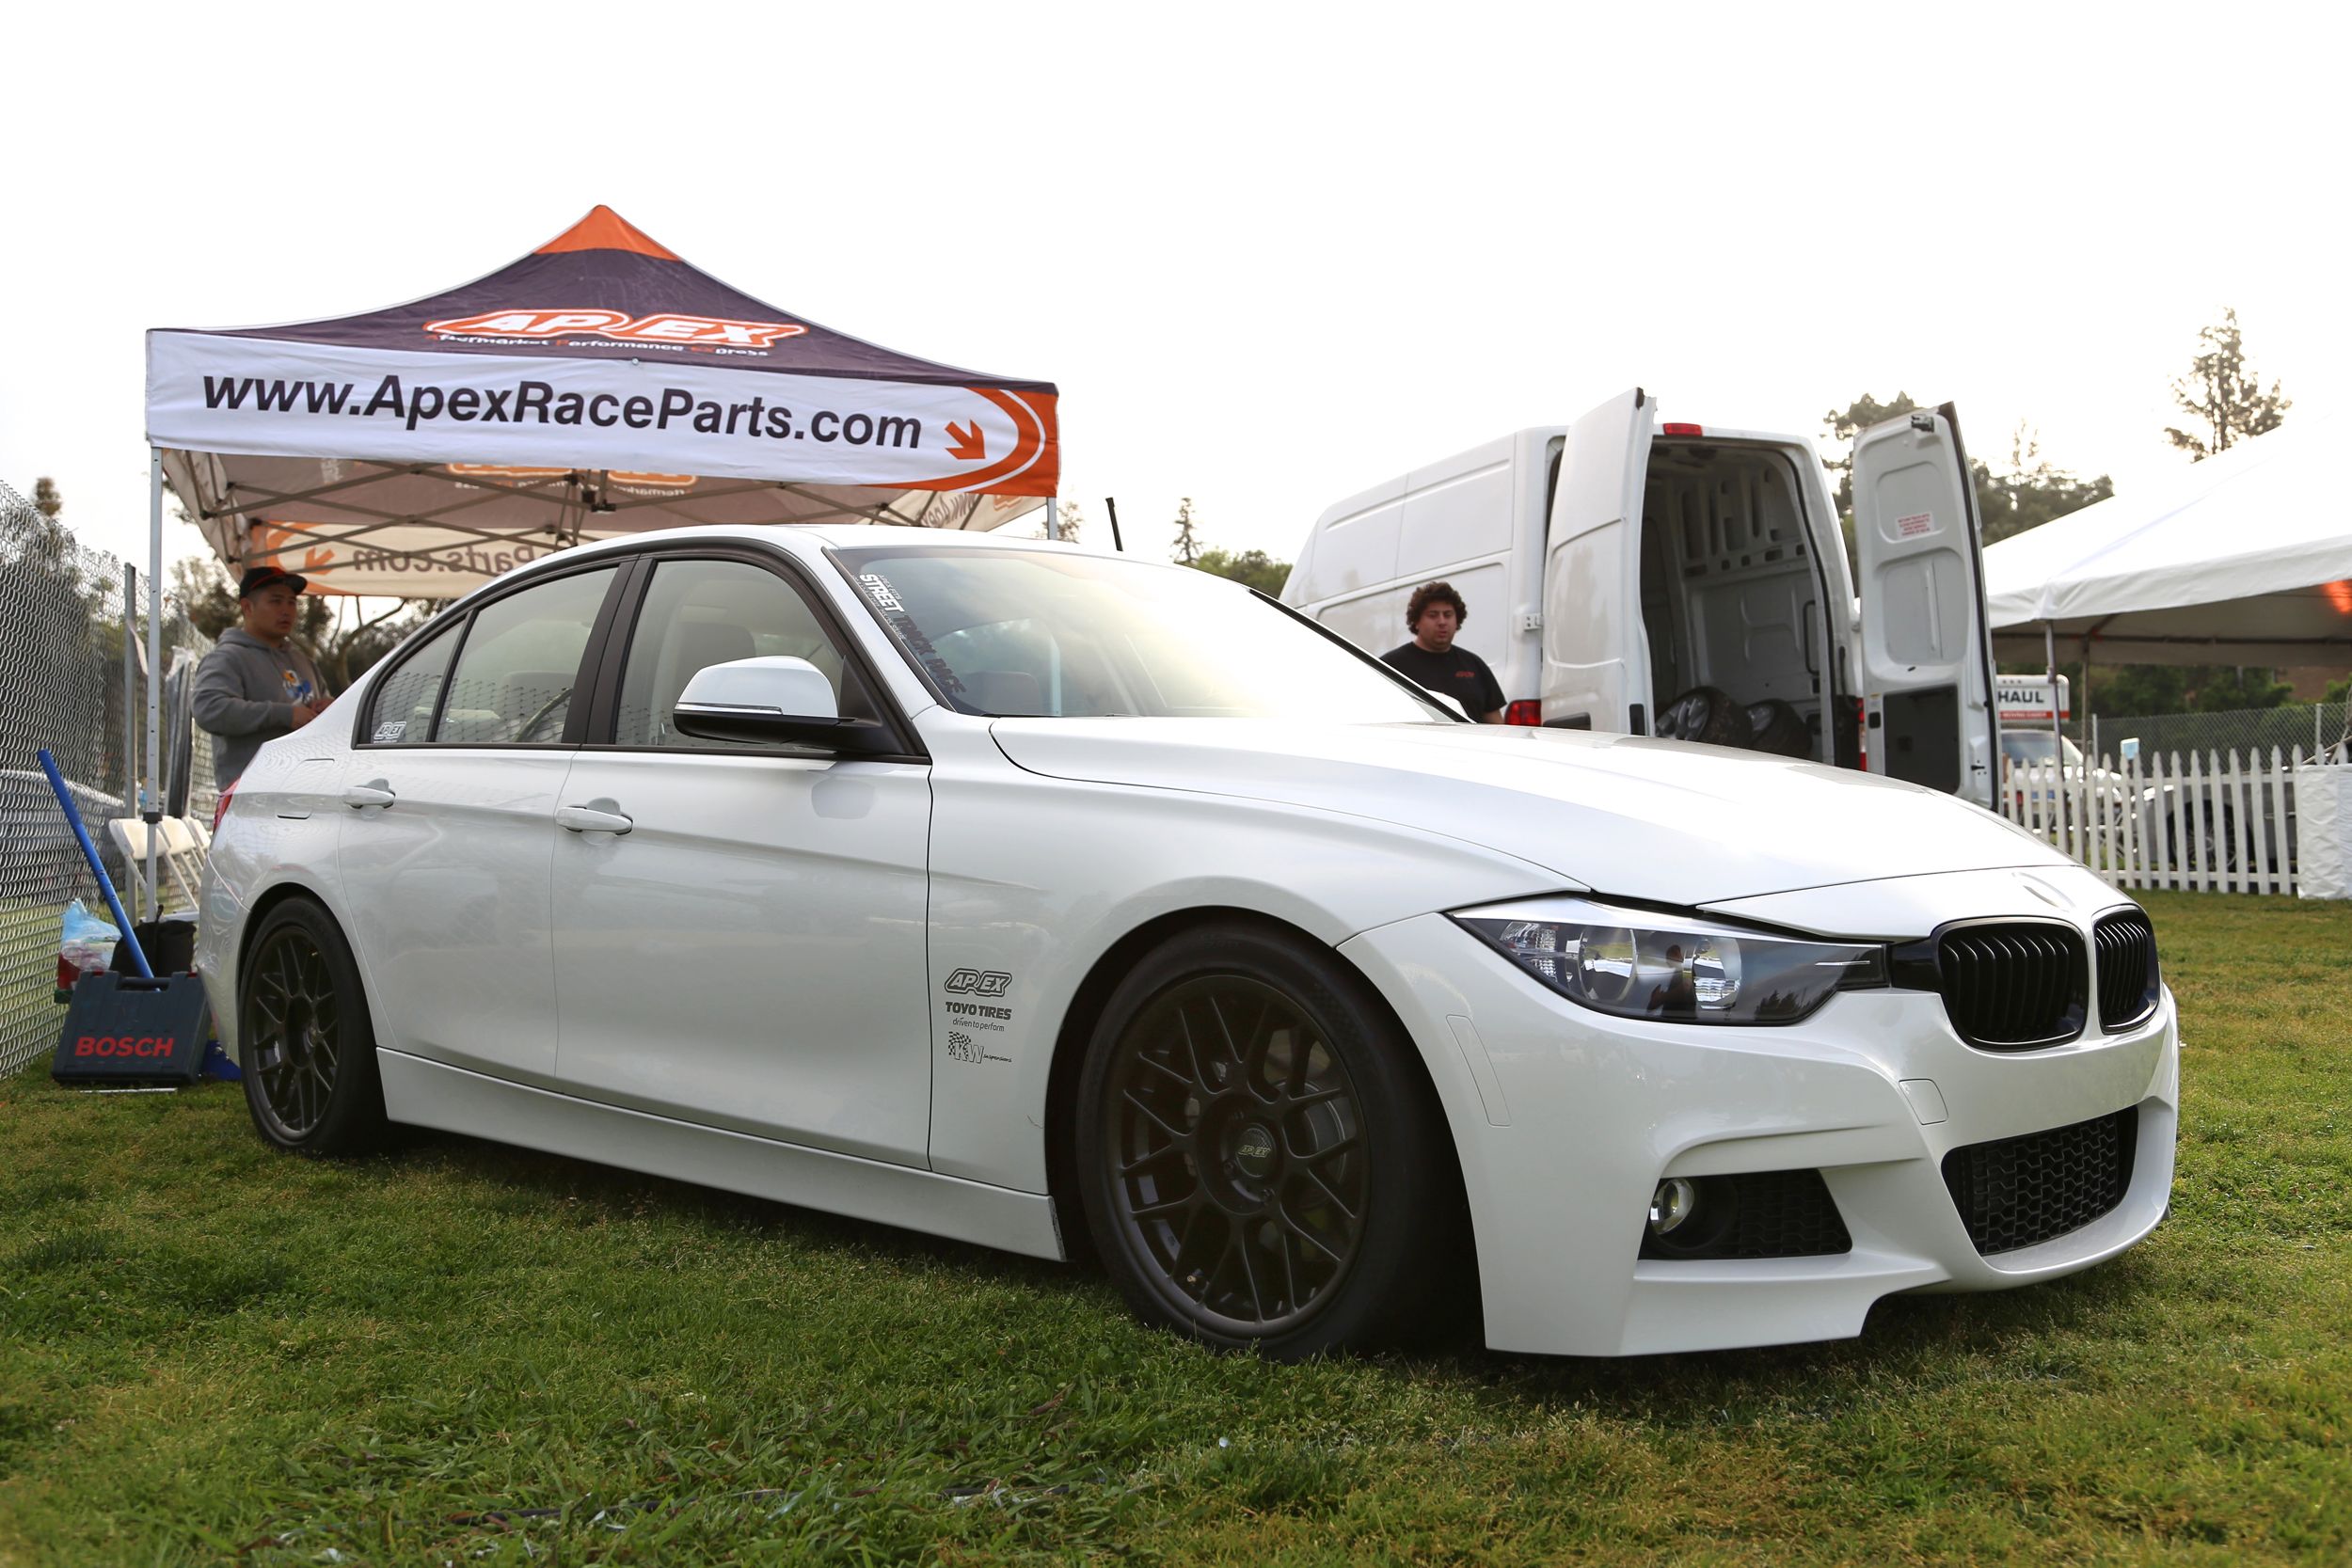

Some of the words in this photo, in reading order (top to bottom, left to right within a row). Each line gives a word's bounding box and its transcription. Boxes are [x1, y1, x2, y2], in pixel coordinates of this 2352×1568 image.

[555, 339, 684, 352] Performance
[202, 373, 924, 450] www.ApexRaceParts.com
[859, 573, 905, 613] STREET
[1997, 689, 2044, 704] HAUL
[947, 970, 1009, 994] APEX
[946, 1001, 977, 1017] TOYO
[978, 1005, 1012, 1021] TIRES
[952, 1017, 972, 1027] driven
[972, 1020, 979, 1029] to
[979, 1021, 1005, 1032] perform
[74, 1037, 175, 1058] BOSCH
[954, 1040, 984, 1064] KW
